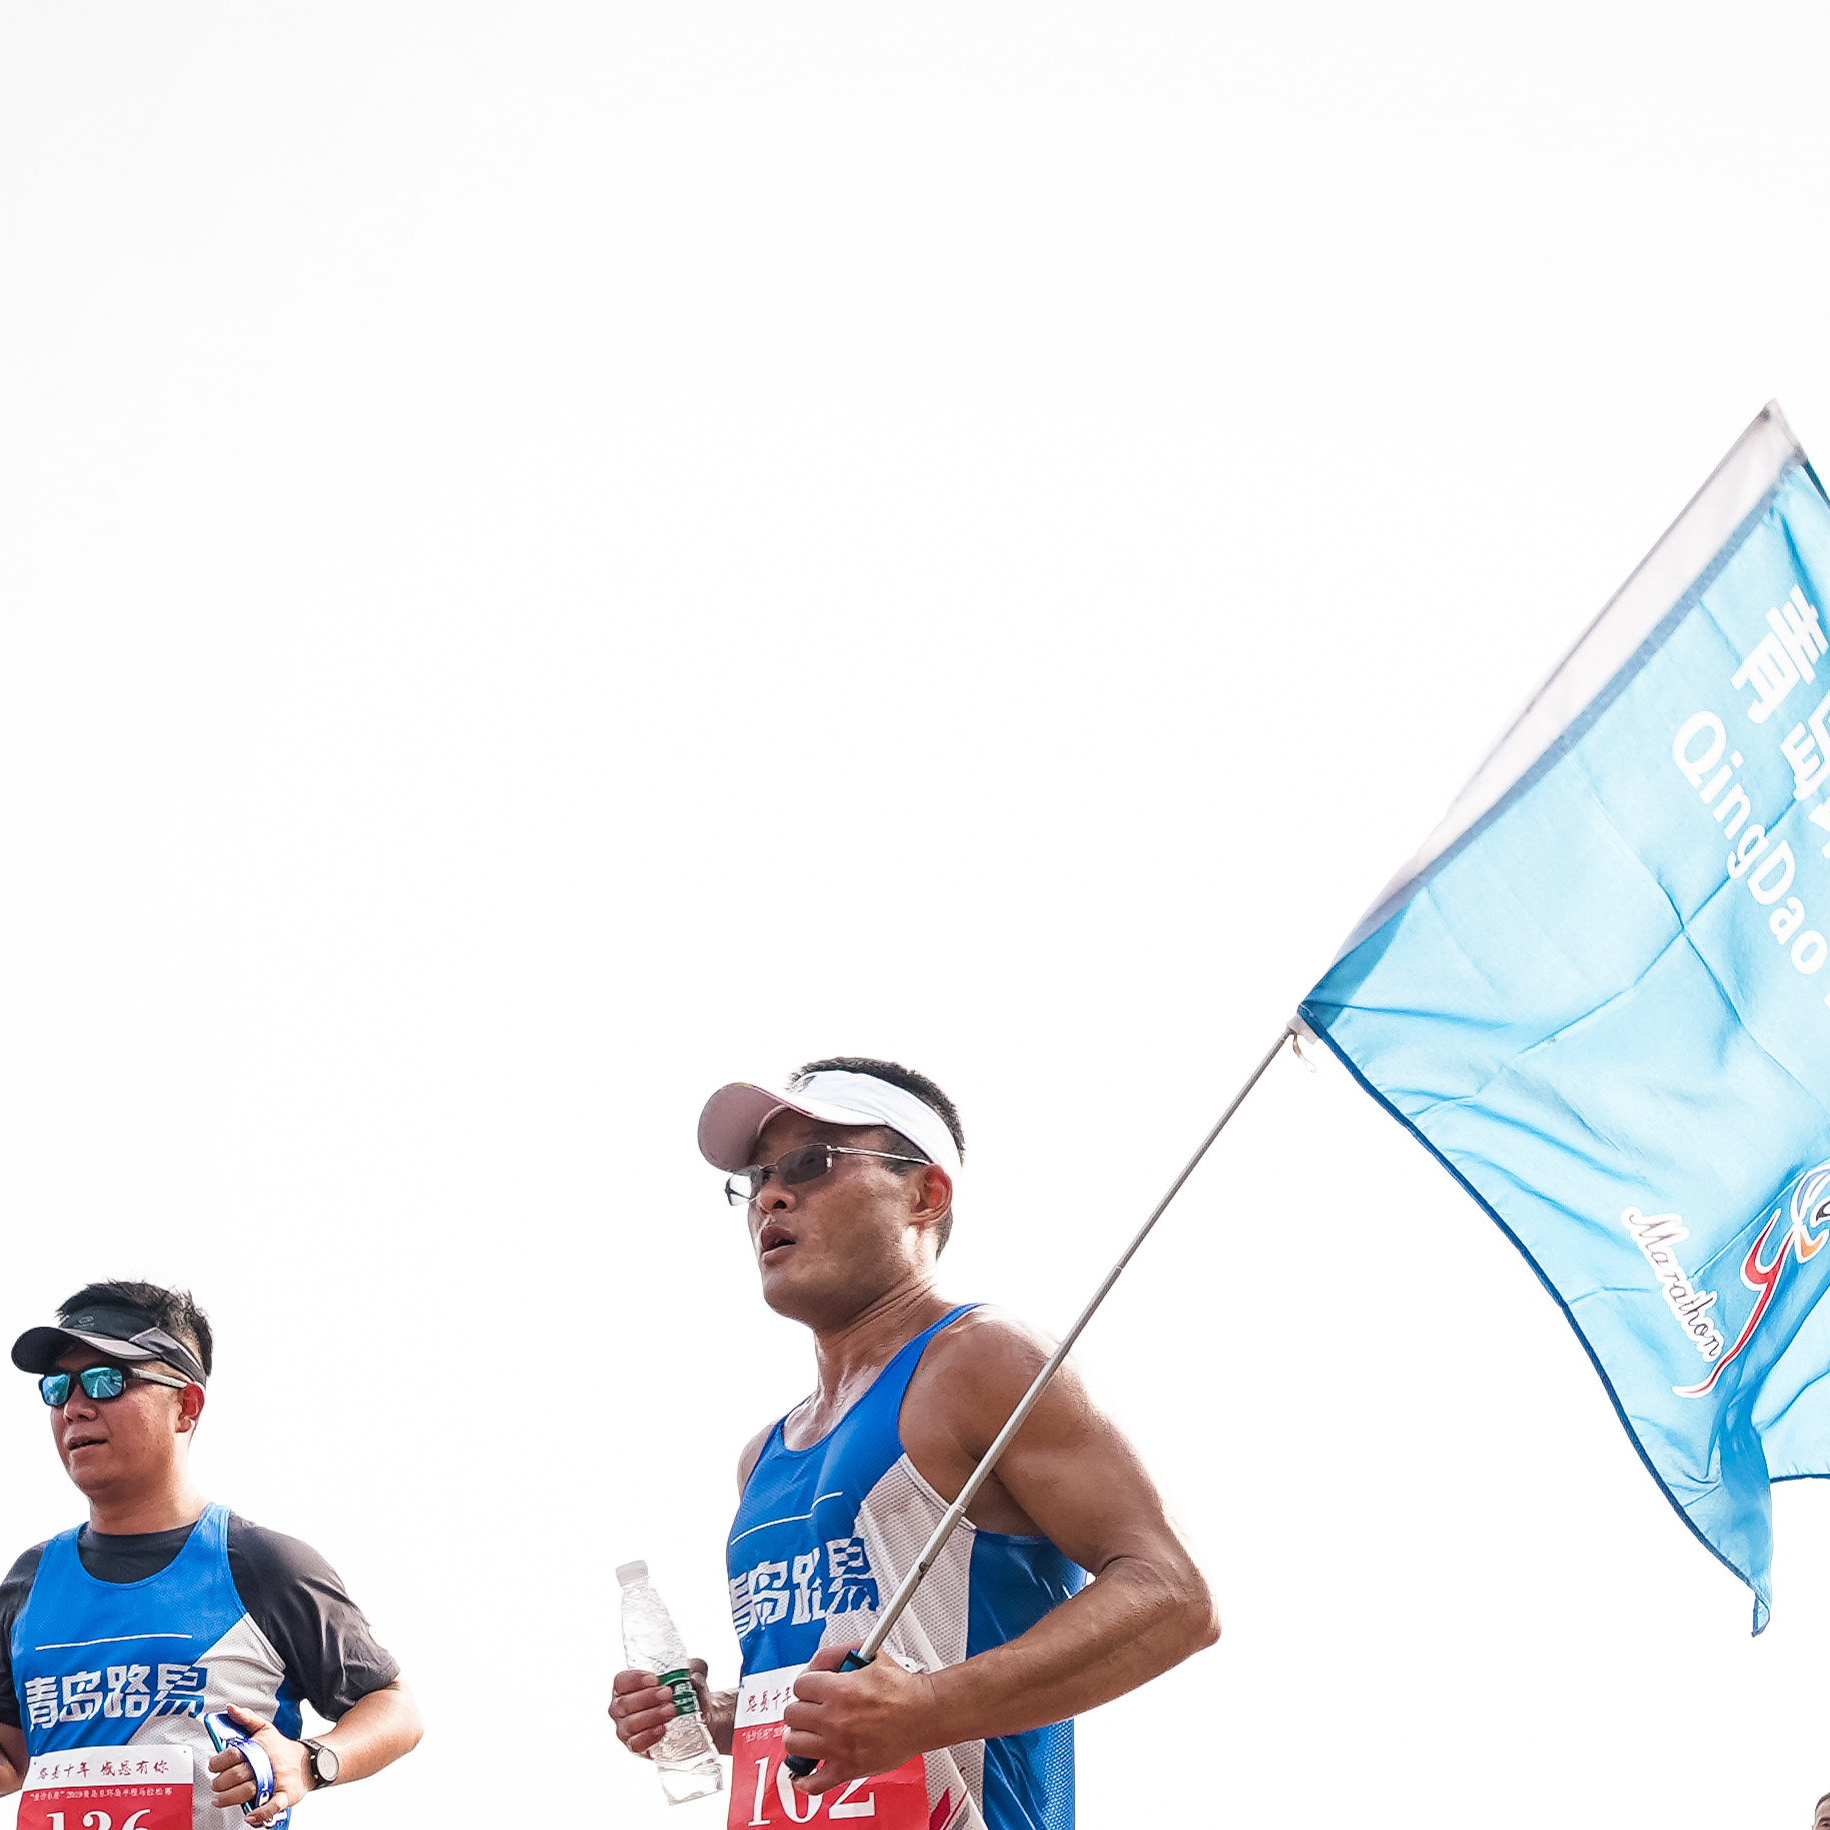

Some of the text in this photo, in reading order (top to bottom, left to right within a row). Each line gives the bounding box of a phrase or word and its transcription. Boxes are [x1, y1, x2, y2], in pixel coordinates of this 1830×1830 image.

[1671, 710, 1829, 975] QingDao
[1627, 1212, 1722, 1358] Marathon
[24, 1662, 209, 1732] 青岛路易
